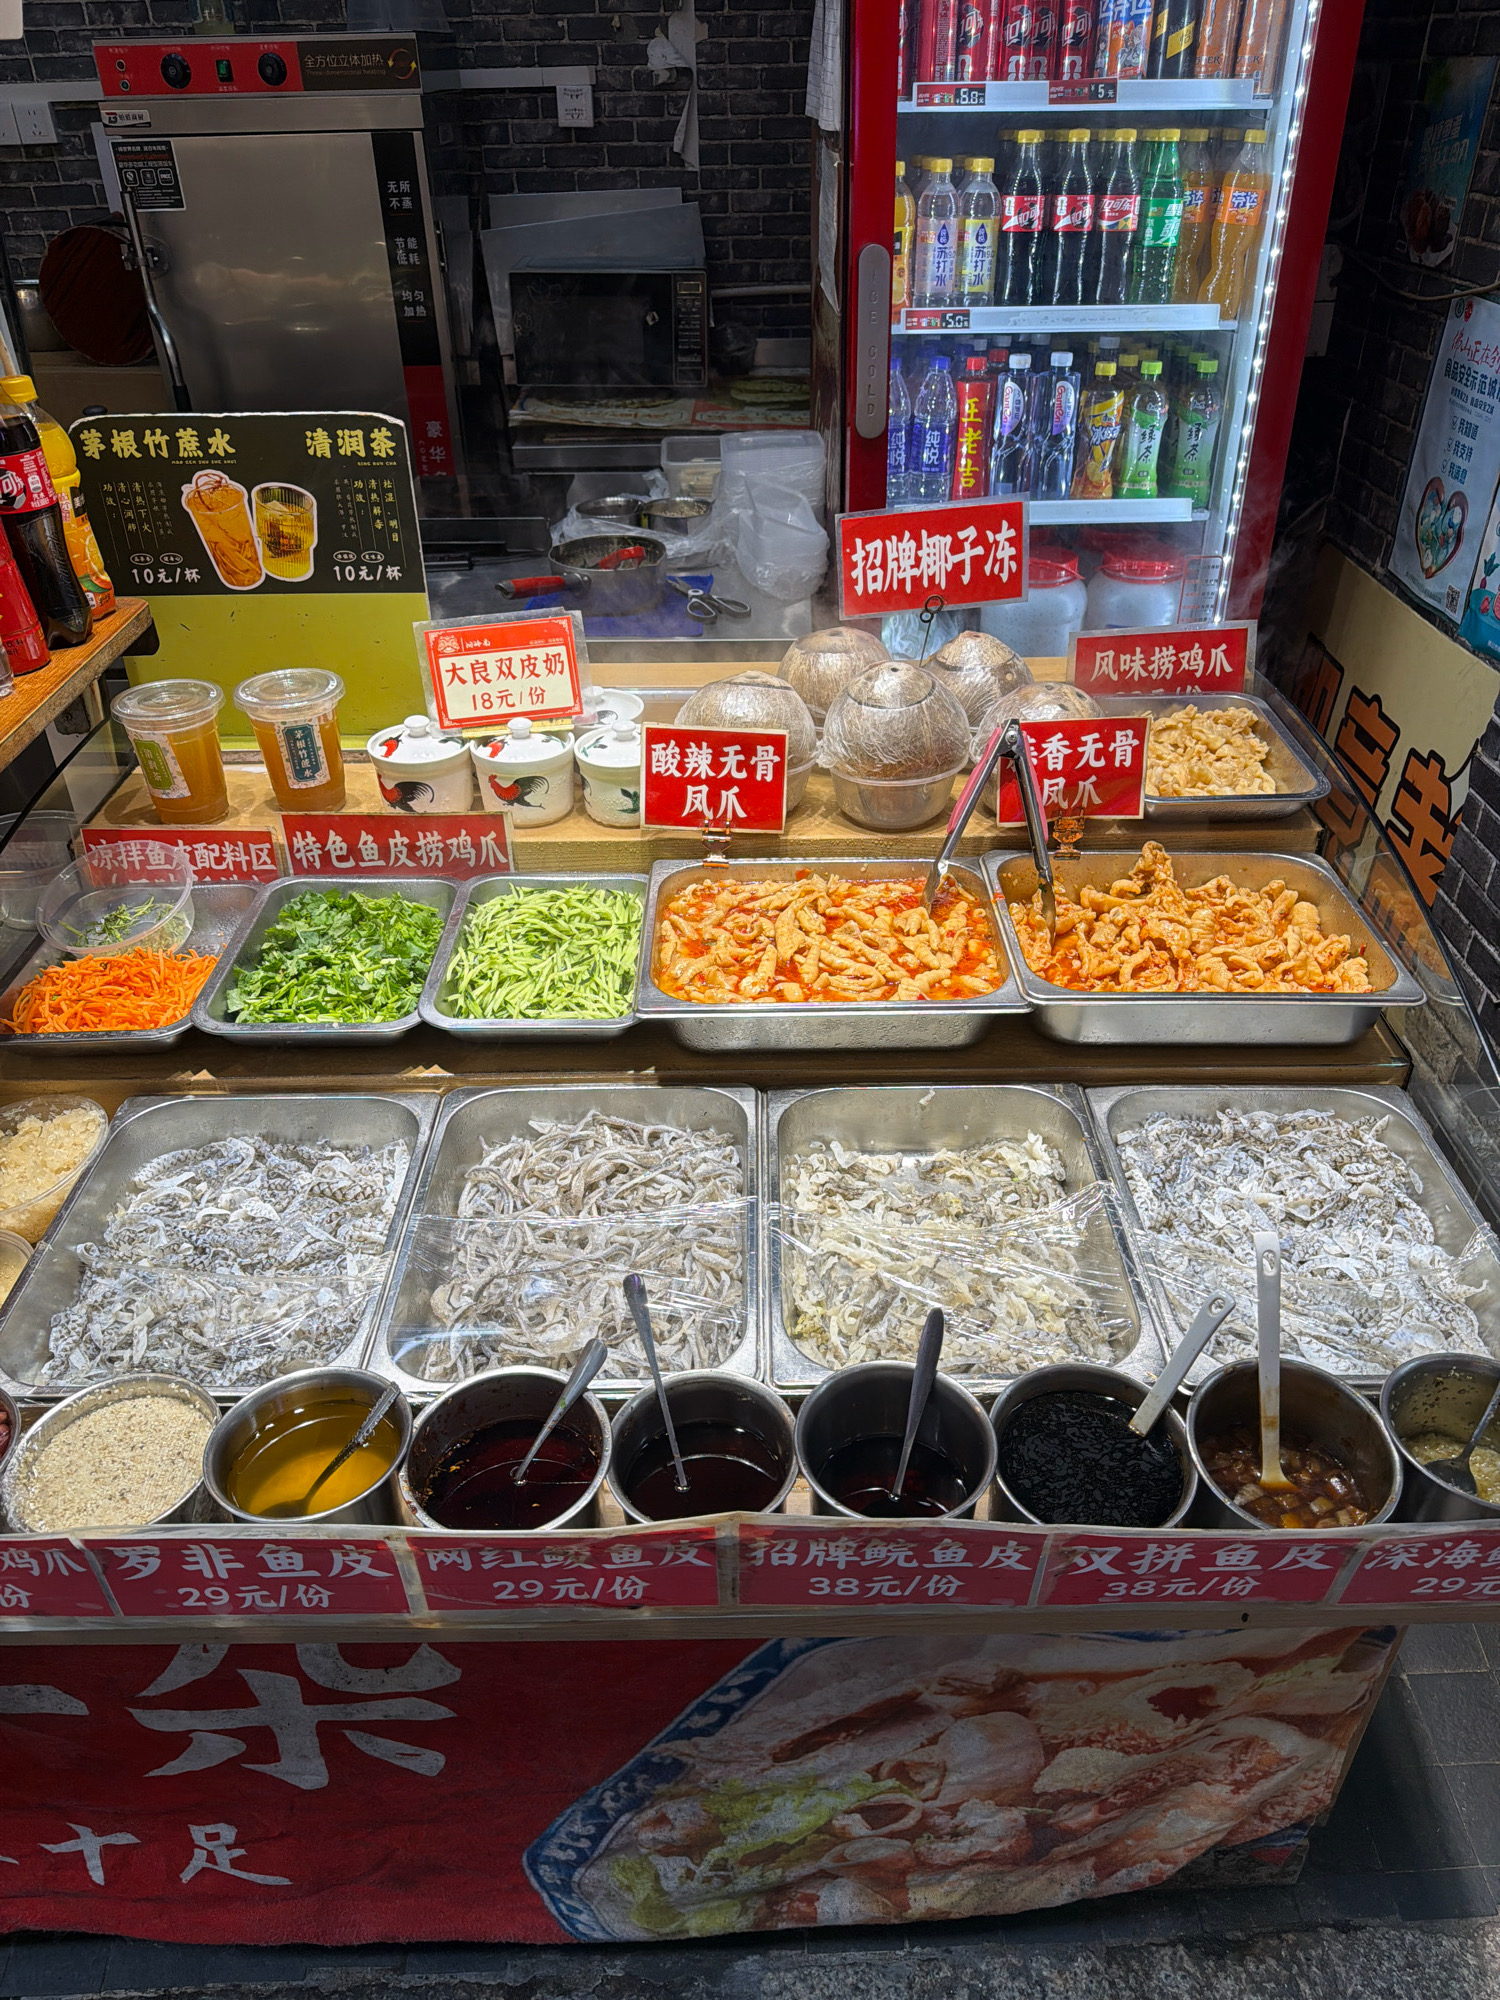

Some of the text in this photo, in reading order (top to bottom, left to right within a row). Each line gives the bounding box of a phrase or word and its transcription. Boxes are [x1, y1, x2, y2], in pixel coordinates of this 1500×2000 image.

[304, 53, 384, 68] 全方位立体加热
[387, 180, 411, 193] 无所
[389, 197, 413, 210] 不蒸
[394, 236, 418, 250] 节能
[396, 250, 421, 265] 低耗
[935, 246, 948, 287] 苏打水
[972, 245, 987, 286] 苏打水
[401, 290, 425, 302] 均匀
[403, 305, 427, 317] 加热
[79, 427, 236, 460] 茅根竹蔗水
[305, 427, 397, 459] 清润茶
[924, 429, 941, 465] 纯悦
[959, 397, 983, 488] 王老吉
[1138, 424, 1156, 463] 绿茶
[1184, 422, 1202, 462] 绿茶
[131, 482, 152, 533] 清热下火
[132, 567, 201, 584] 10元/杯
[333, 565, 402, 581] 10元/杯
[850, 519, 1018, 597] 招牌椰子冻
[445, 652, 565, 688] 大良双皮奶
[1090, 642, 1234, 682] 风味捞鸡爪
[472, 685, 547, 712] 18元/份
[651, 740, 781, 783] 酸辣无骨
[681, 786, 748, 821] 凤爪
[1042, 774, 1103, 810] 凤爪
[87, 838, 277, 873] 凉拌鱼皮配料区
[292, 829, 508, 870] 特色鱼皮捞鸡爪
[105, 1543, 395, 1581] 罗非鱼皮
[1048, 1541, 1335, 1576] 双拼鱼皮
[177, 1583, 336, 1609] 29元/份
[493, 1575, 651, 1601] 29元/份
[808, 1574, 966, 1598] 38元/份
[1104, 1576, 1262, 1597] 38元/份
